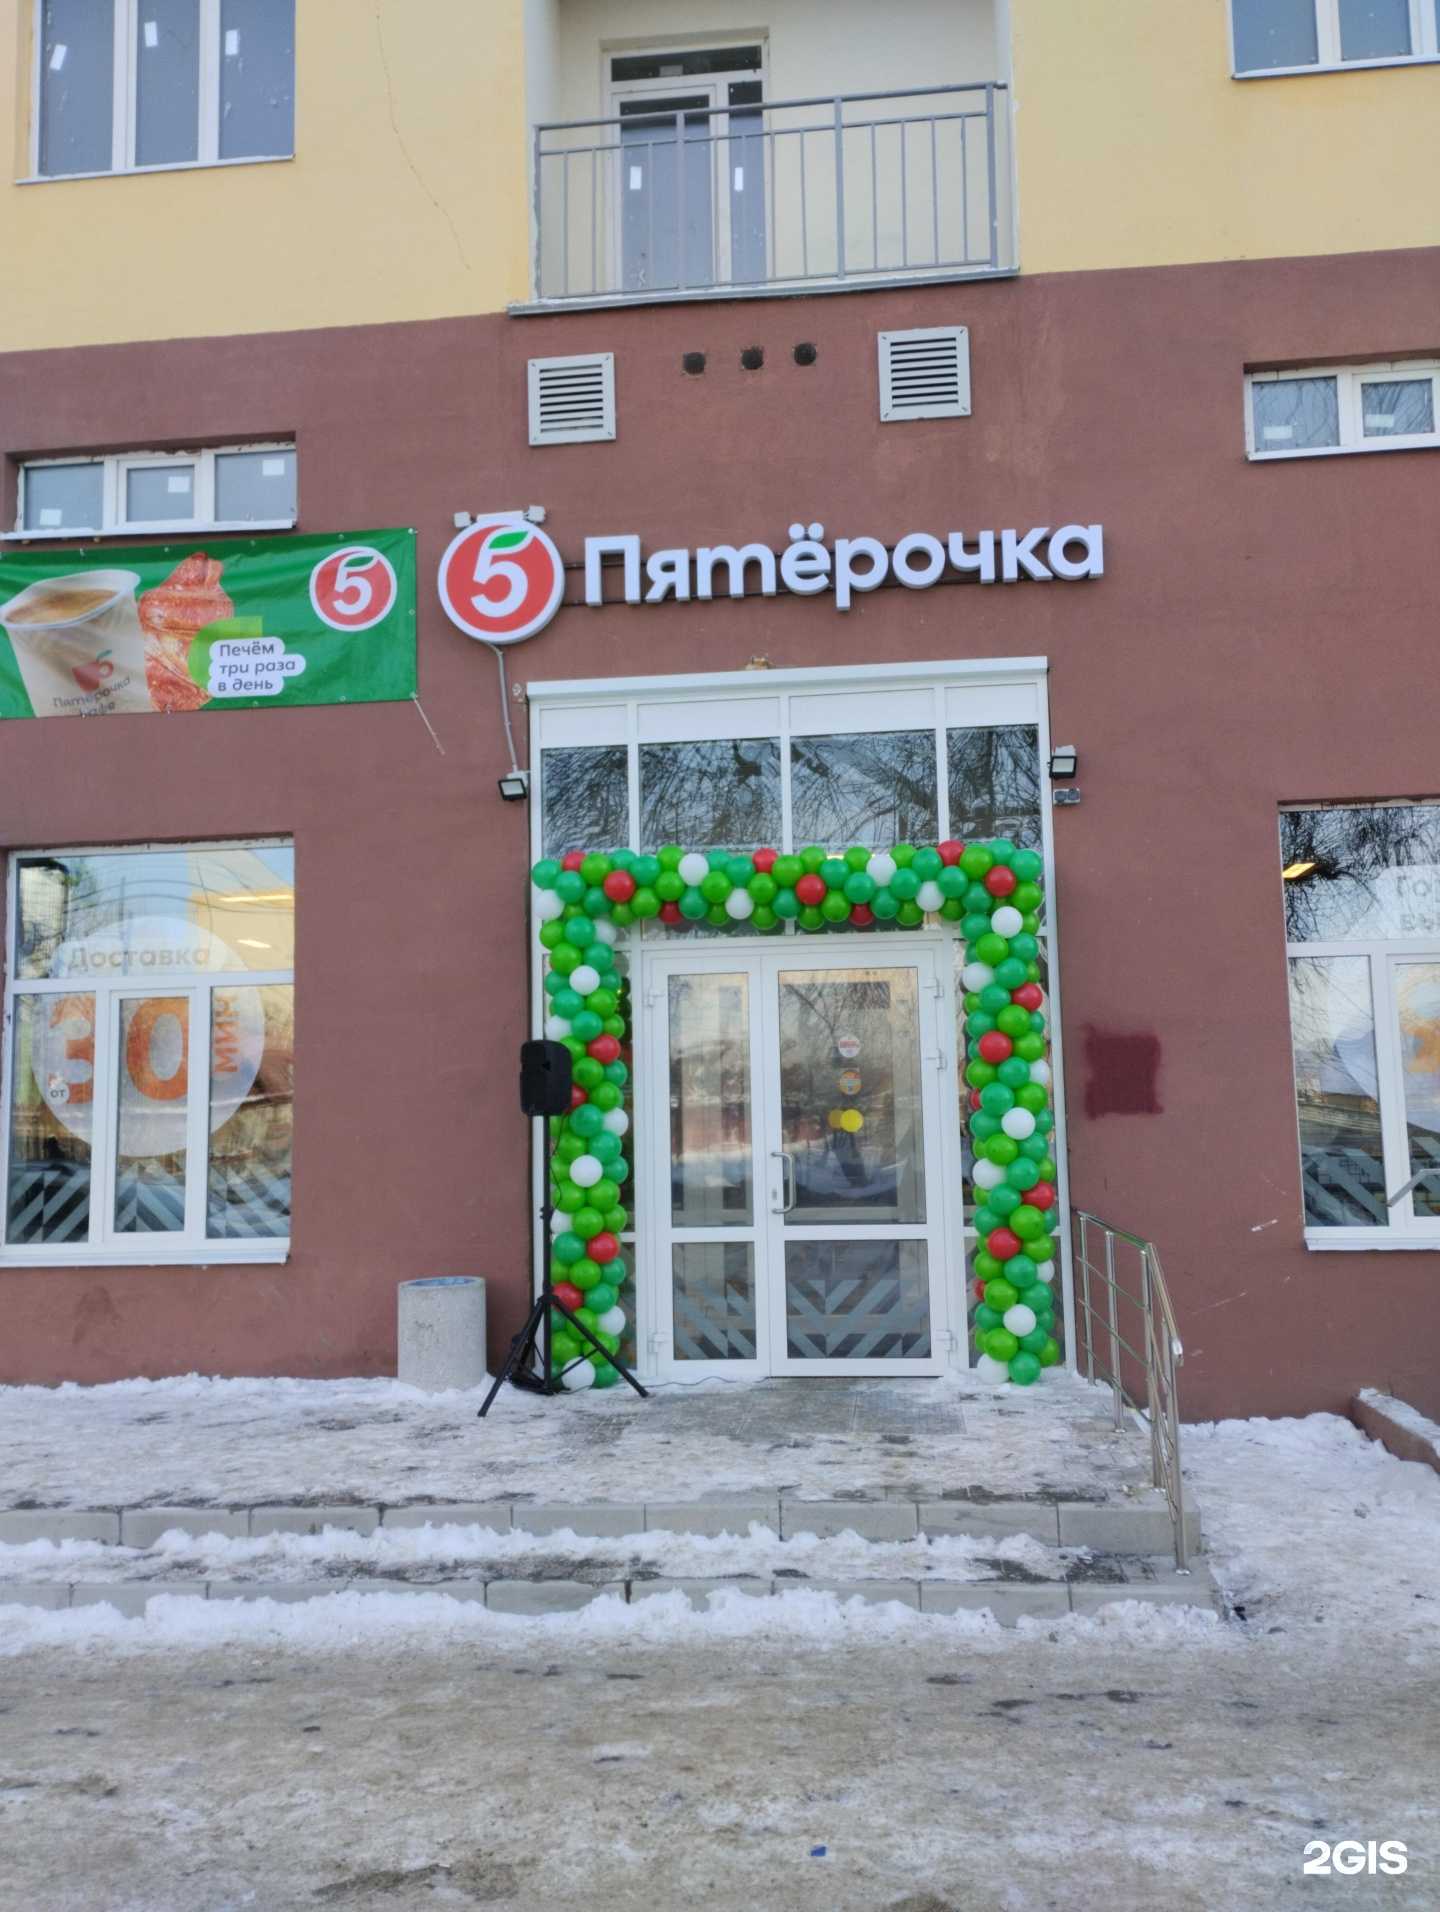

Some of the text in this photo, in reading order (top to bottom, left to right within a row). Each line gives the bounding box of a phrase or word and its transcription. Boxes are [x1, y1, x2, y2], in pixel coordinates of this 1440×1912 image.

[332, 554, 379, 615] 5
[470, 528, 535, 618] 5
[584, 522, 1104, 611] Пятёрочка
[219, 641, 275, 657] Печём
[220, 661, 296, 677] три раза
[217, 678, 273, 692] в день
[68, 946, 210, 973] Доставка
[49, 993, 190, 1104] 30
